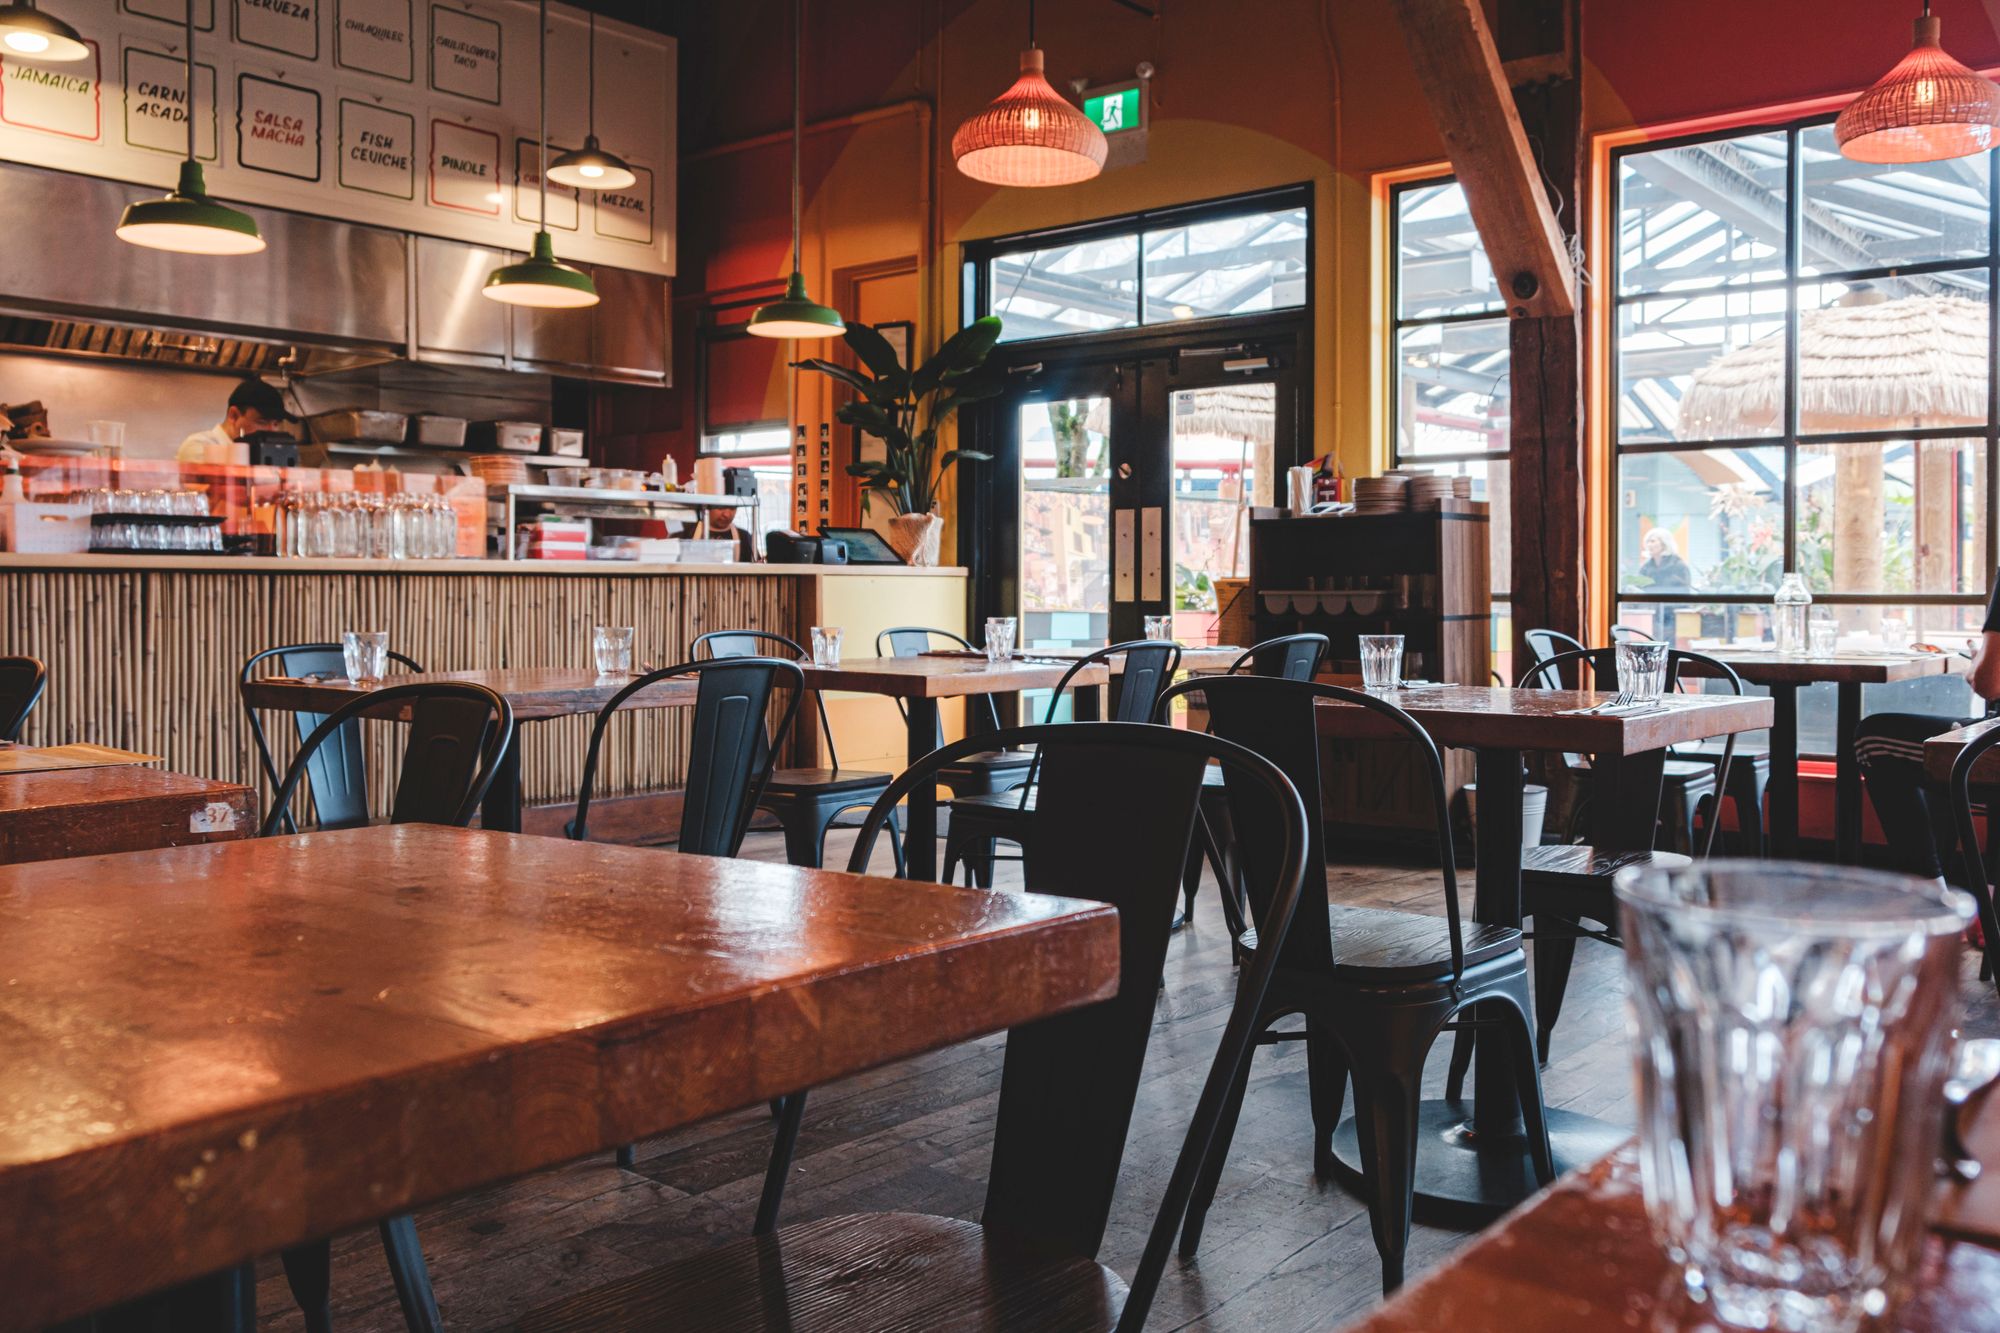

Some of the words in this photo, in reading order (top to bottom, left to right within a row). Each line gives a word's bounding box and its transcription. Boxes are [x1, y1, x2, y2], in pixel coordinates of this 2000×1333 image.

[453, 54, 477, 69] TACO
[10, 66, 90, 95] JAMAICA
[138, 82, 187, 104] CARN
[254, 109, 304, 132] SALSA
[251, 125, 305, 147] MACHA
[361, 131, 393, 148] FISH
[351, 146, 407, 170] CEVICHE
[441, 155, 487, 176] PINOLE
[601, 192, 645, 211] MEZCAL
